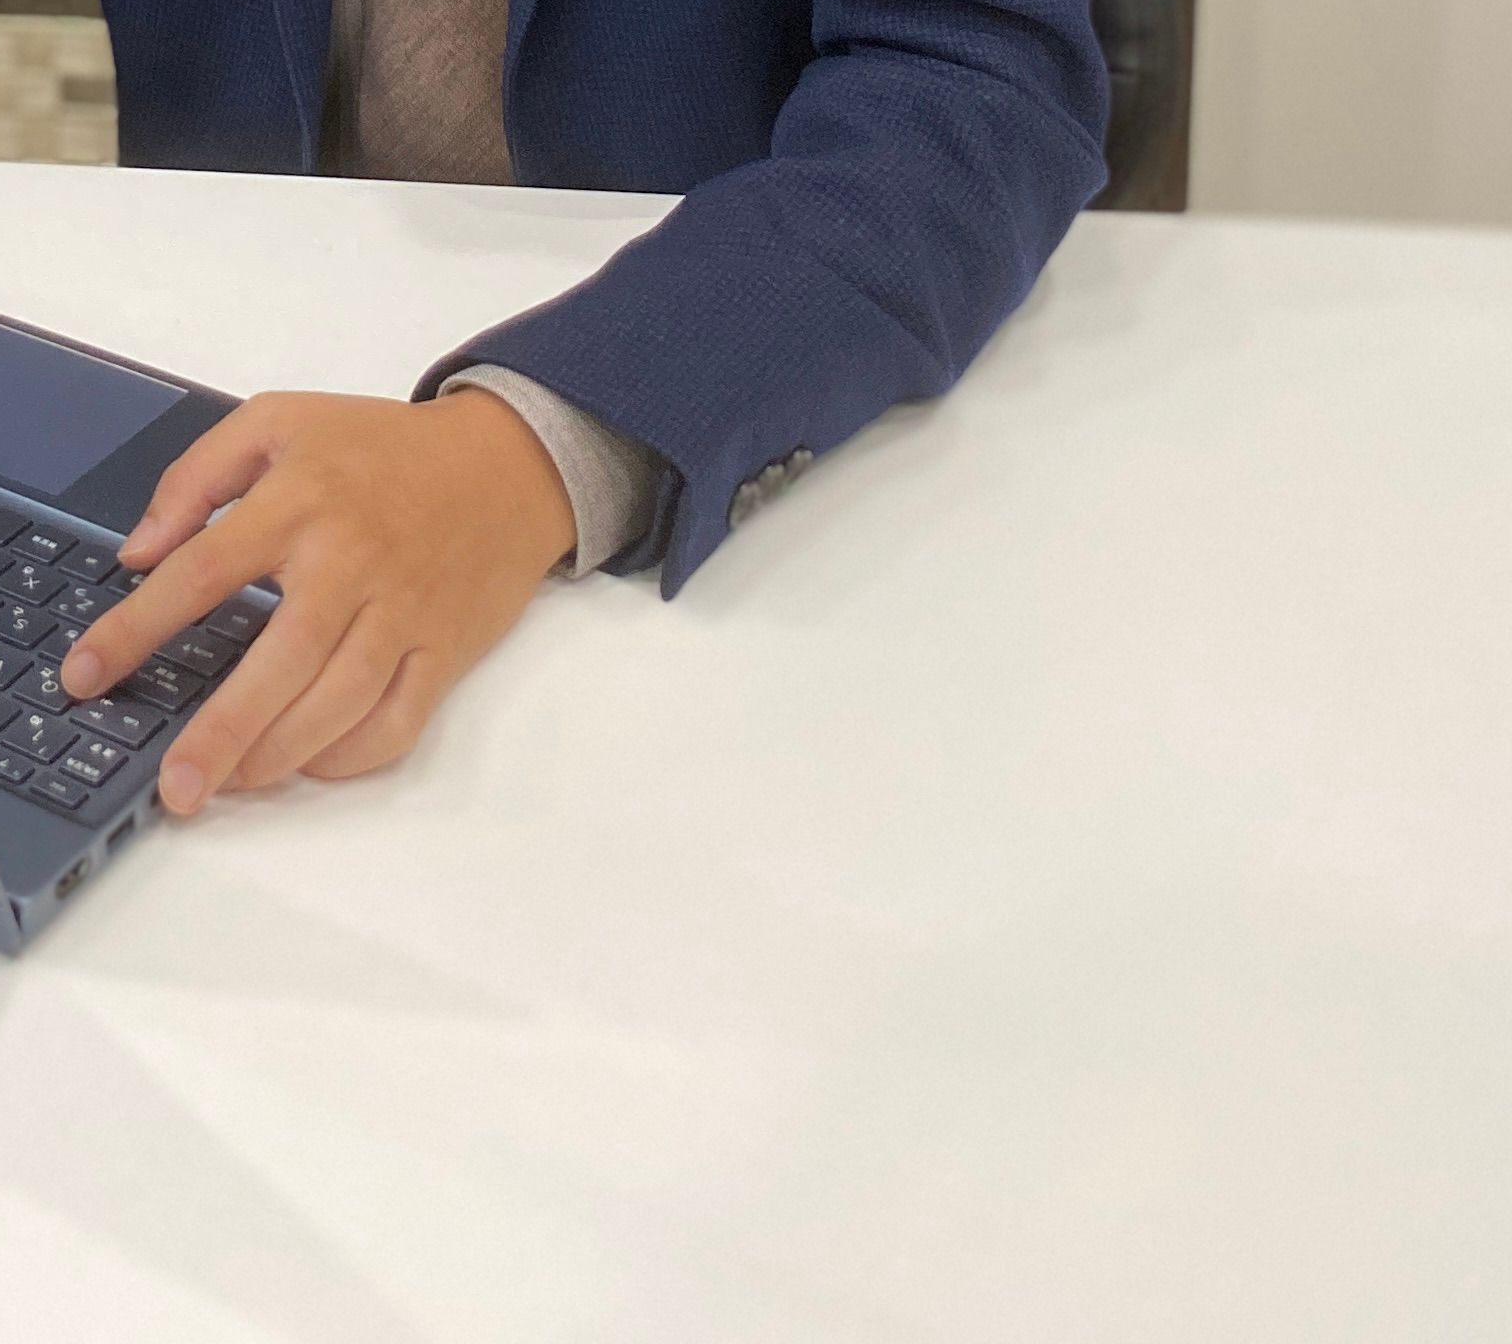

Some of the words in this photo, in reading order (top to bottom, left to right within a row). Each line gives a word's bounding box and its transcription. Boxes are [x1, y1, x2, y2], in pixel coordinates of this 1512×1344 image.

[22, 576, 41, 590] X
[76, 598, 95, 611] Z
[12, 618, 28, 630] S
[41, 680, 59, 693] Q
